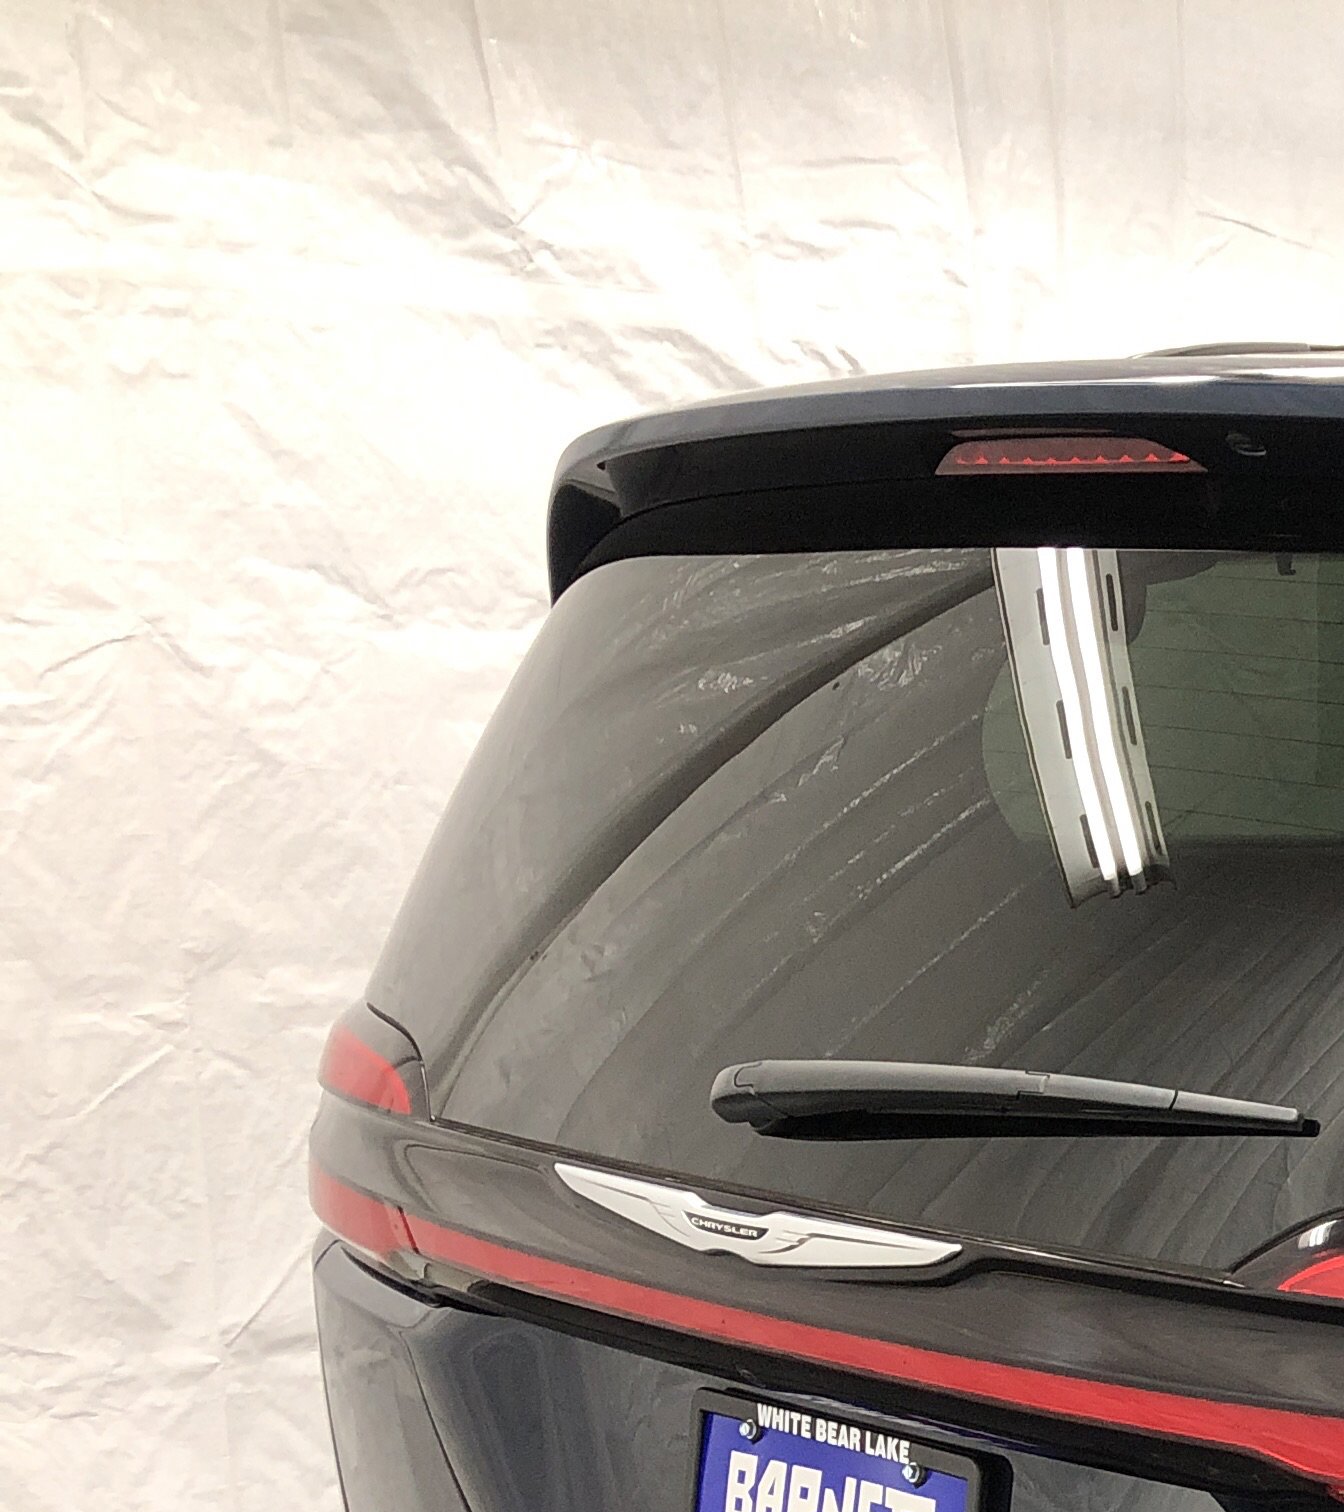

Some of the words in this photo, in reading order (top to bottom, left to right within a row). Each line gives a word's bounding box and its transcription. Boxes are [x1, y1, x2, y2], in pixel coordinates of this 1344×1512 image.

[691, 1217, 758, 1237] CHRYSLER
[757, 1403, 812, 1439] WHITE
[815, 1418, 861, 1451] BEAR
[864, 1430, 911, 1465] LAKE
